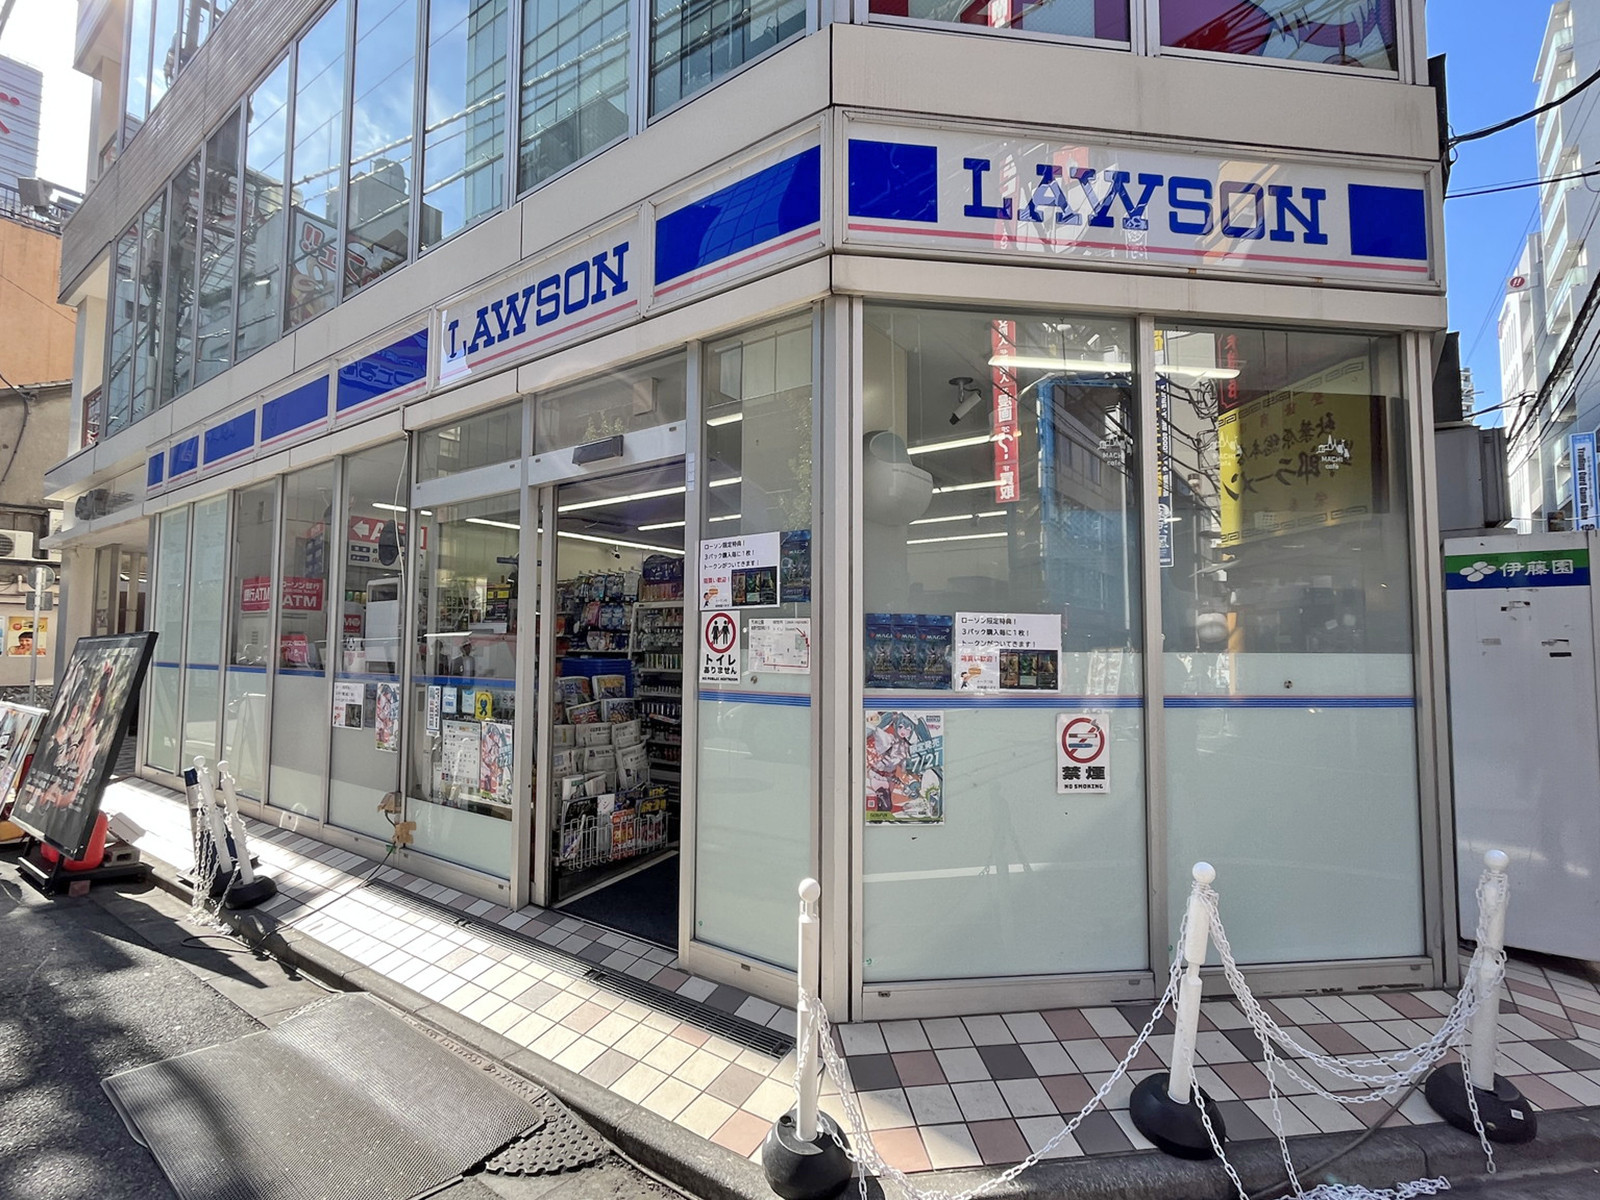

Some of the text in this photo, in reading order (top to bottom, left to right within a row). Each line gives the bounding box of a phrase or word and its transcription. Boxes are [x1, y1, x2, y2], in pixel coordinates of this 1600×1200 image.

[962, 157, 1329, 247] LAWSON
[447, 241, 629, 363] LAWSON
[1499, 559, 1574, 578] 伊藤園
[282, 595, 317, 607] ATM
[705, 653, 737, 666] トイレ
[703, 666, 738, 675] ありません
[910, 752, 940, 773] 7/21
[1061, 765, 1106, 780] 禁煙
